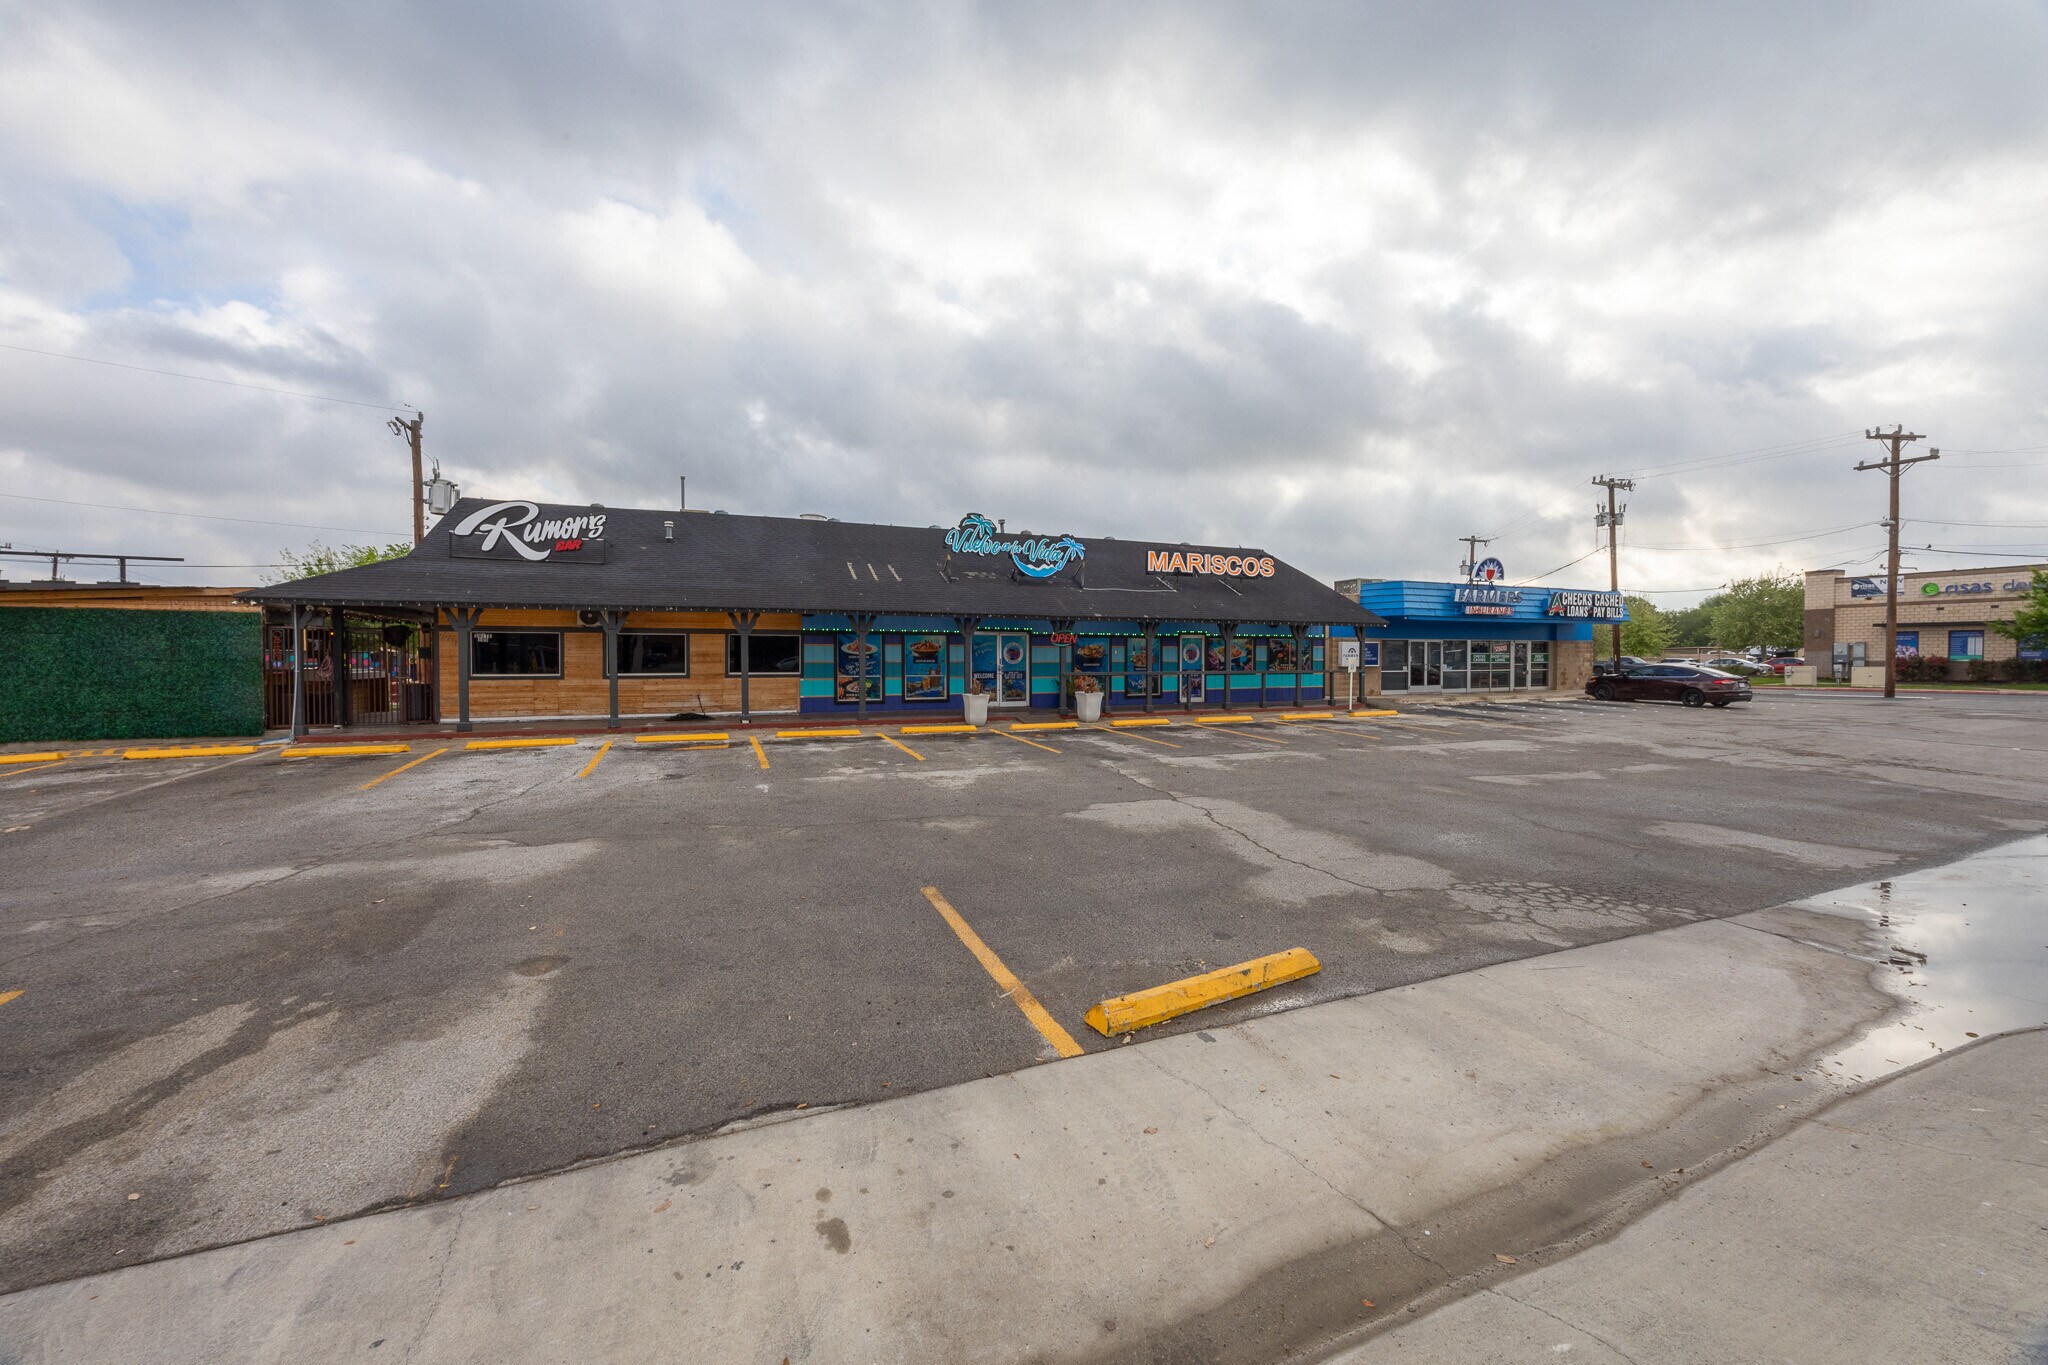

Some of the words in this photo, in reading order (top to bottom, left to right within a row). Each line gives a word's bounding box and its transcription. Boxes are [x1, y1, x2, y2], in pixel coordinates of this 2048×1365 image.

[555, 539, 583, 552] BAR
[945, 528, 1001, 557] Vuelve
[1023, 537, 1064, 564] Vida
[1147, 550, 1275, 577] MARISCOS
[1945, 582, 1993, 594] risas
[1454, 588, 1523, 604] FARMERS
[1562, 592, 1593, 606] CHECKS
[1594, 593, 1624, 607] CASHED
[1465, 605, 1514, 615] INSURANCE
[1567, 606, 1588, 617] LOANS
[1593, 607, 1606, 618] PAY
[1606, 608, 1624, 618] BILLS
[1050, 633, 1079, 643] OPEN
